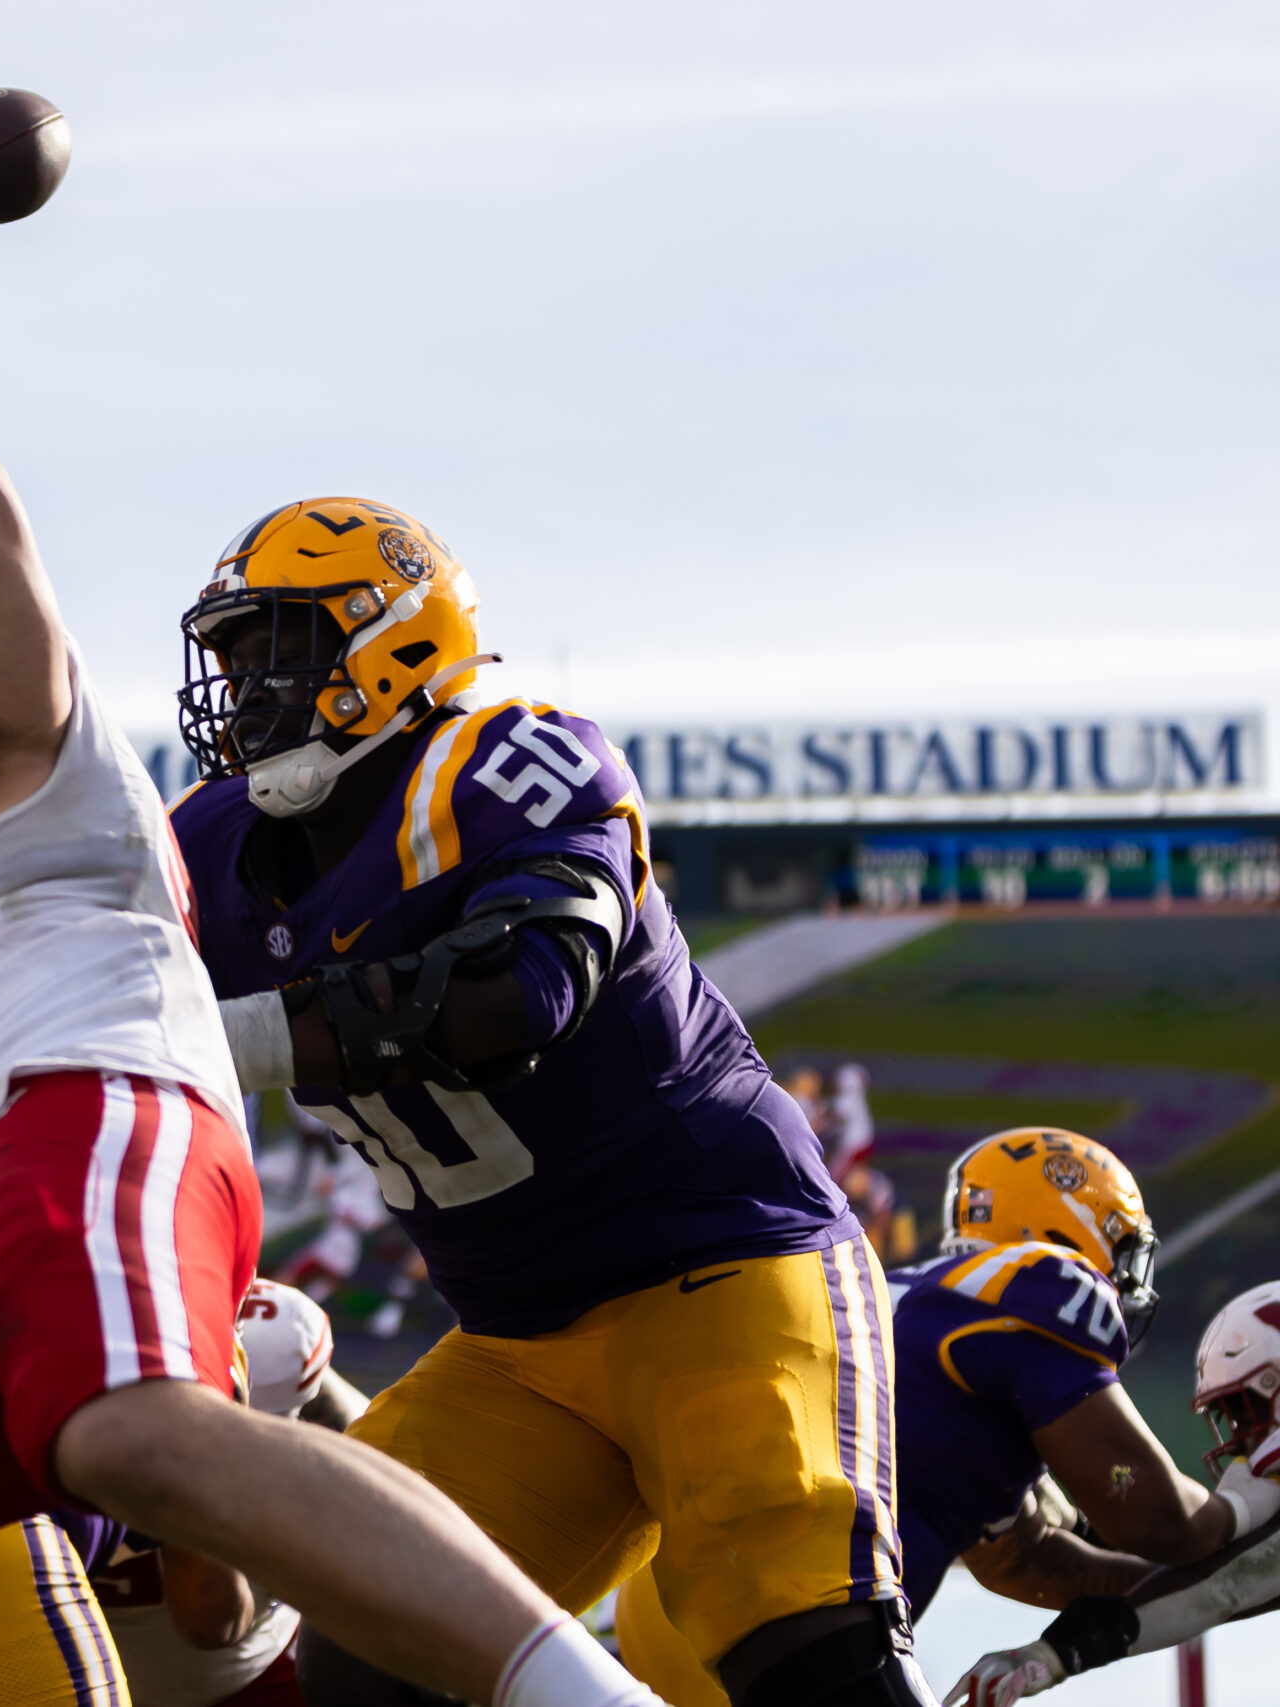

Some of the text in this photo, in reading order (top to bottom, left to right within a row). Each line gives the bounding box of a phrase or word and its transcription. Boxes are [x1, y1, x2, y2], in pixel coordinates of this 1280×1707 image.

[472, 713, 602, 829] 50
[800, 720, 1247, 798] STADIUM
[267, 925, 292, 958] SEC
[1057, 1258, 1122, 1346] 70
